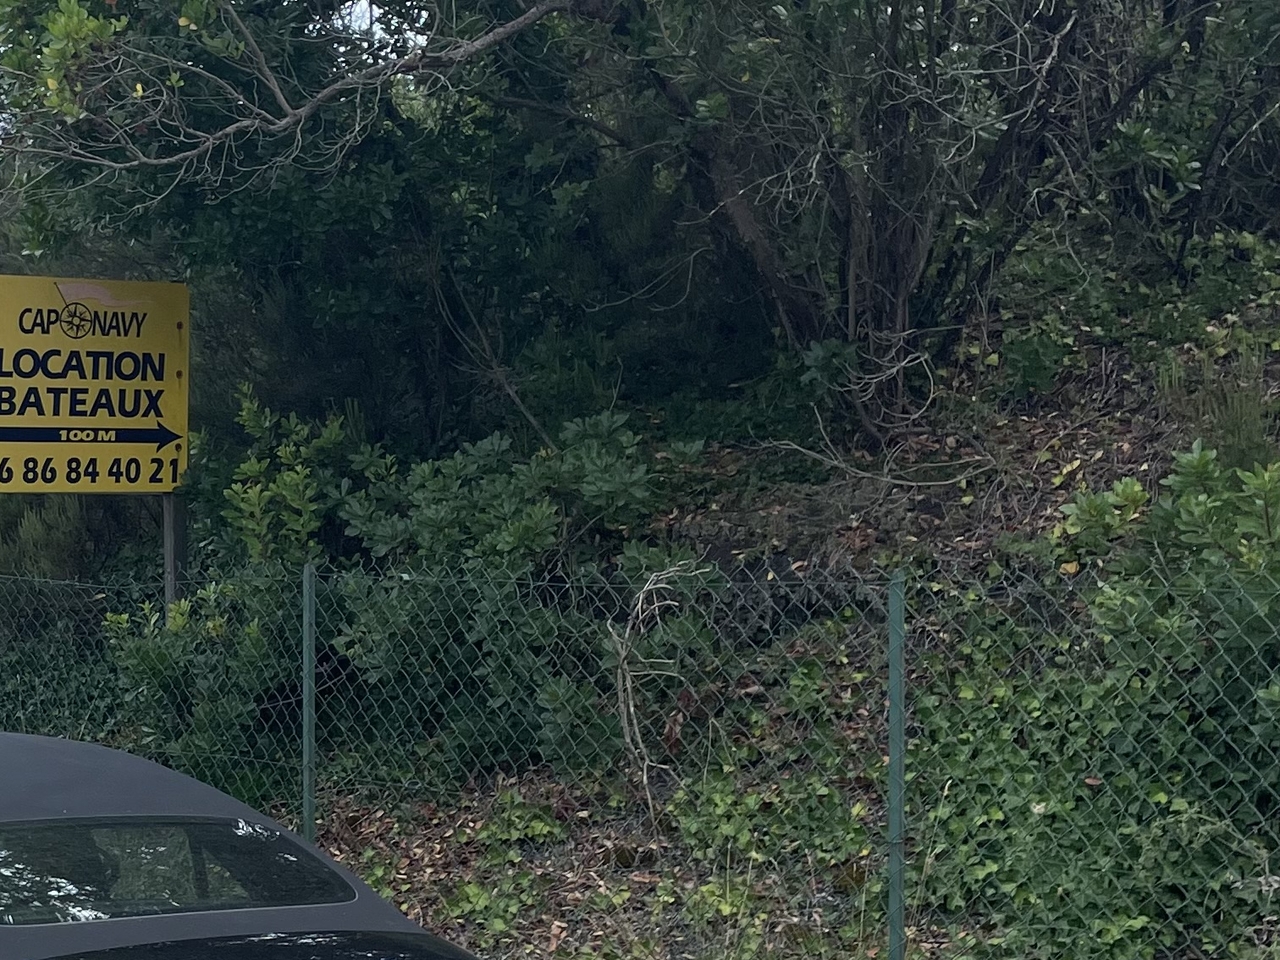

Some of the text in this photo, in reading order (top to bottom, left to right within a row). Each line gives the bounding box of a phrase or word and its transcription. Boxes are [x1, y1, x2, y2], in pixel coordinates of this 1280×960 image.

[19, 308, 147, 338] CAP NAVY
[59, 430, 116, 442] 100 M
[22, 457, 57, 483] 86
[66, 457, 99, 483] 84
[108, 457, 141, 483] 40
[149, 457, 178, 483] 21
